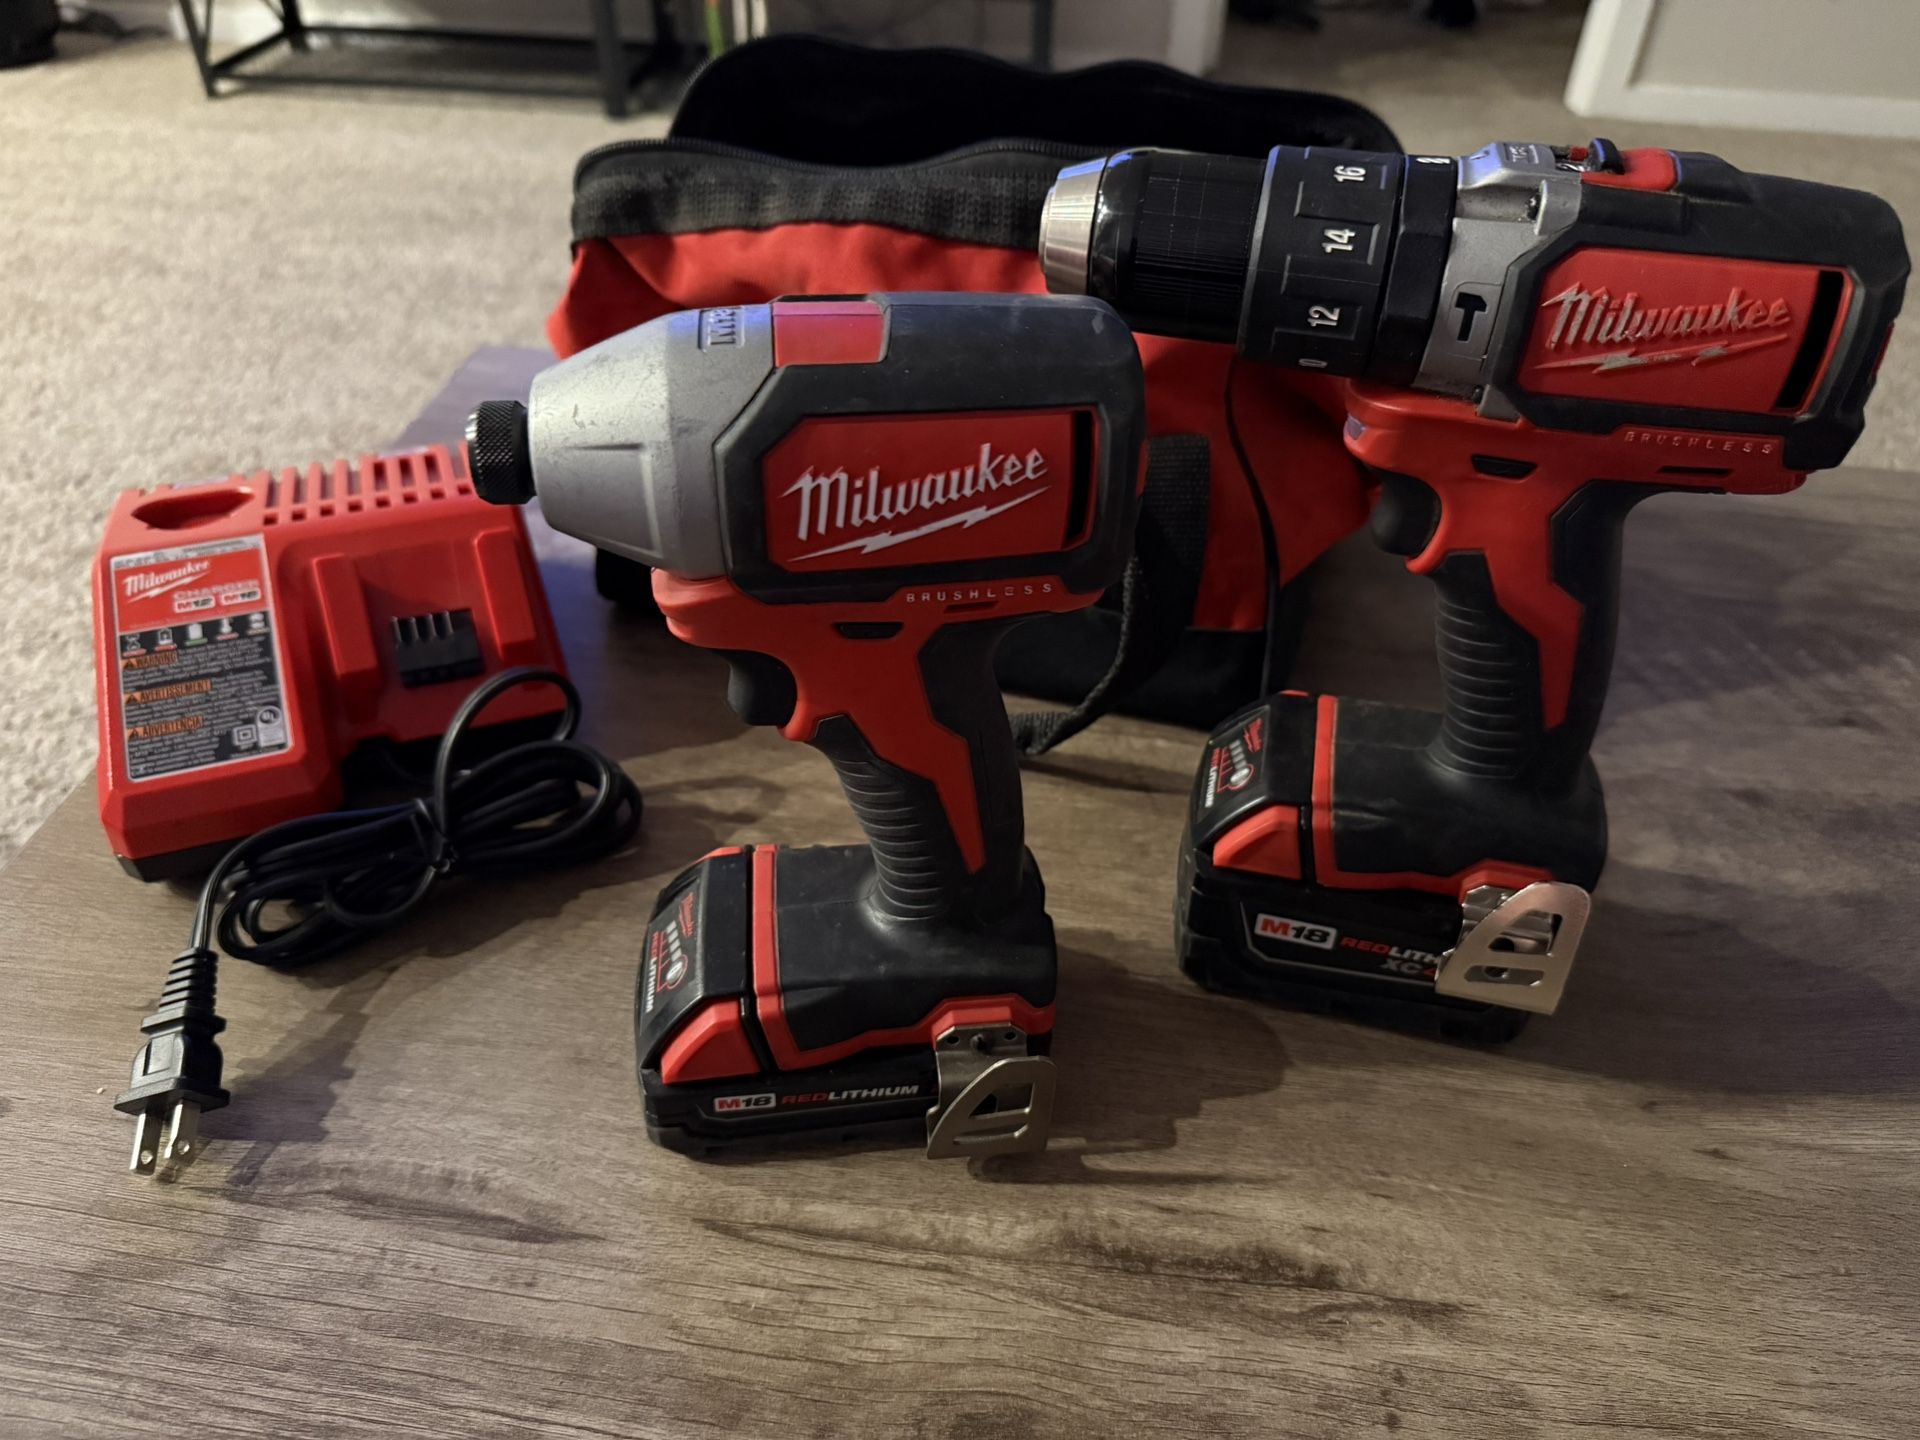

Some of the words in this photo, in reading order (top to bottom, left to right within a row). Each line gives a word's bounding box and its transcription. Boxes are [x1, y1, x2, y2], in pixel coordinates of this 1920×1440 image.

[1333, 164, 1366, 183] 16
[1321, 228, 1356, 254] 14
[1307, 305, 1341, 328] 12
[1541, 280, 1792, 350] Milwaukee
[1623, 431, 1775, 456] BRUSHLESS
[776, 442, 1051, 543] Milwaukee
[905, 583, 1053, 605] BRUSHLESS
[1261, 918, 1331, 944] M18
[1340, 936, 1440, 965] REDLITH
[718, 1095, 773, 1110] M18
[782, 1084, 920, 1106] REDLITHIUM
